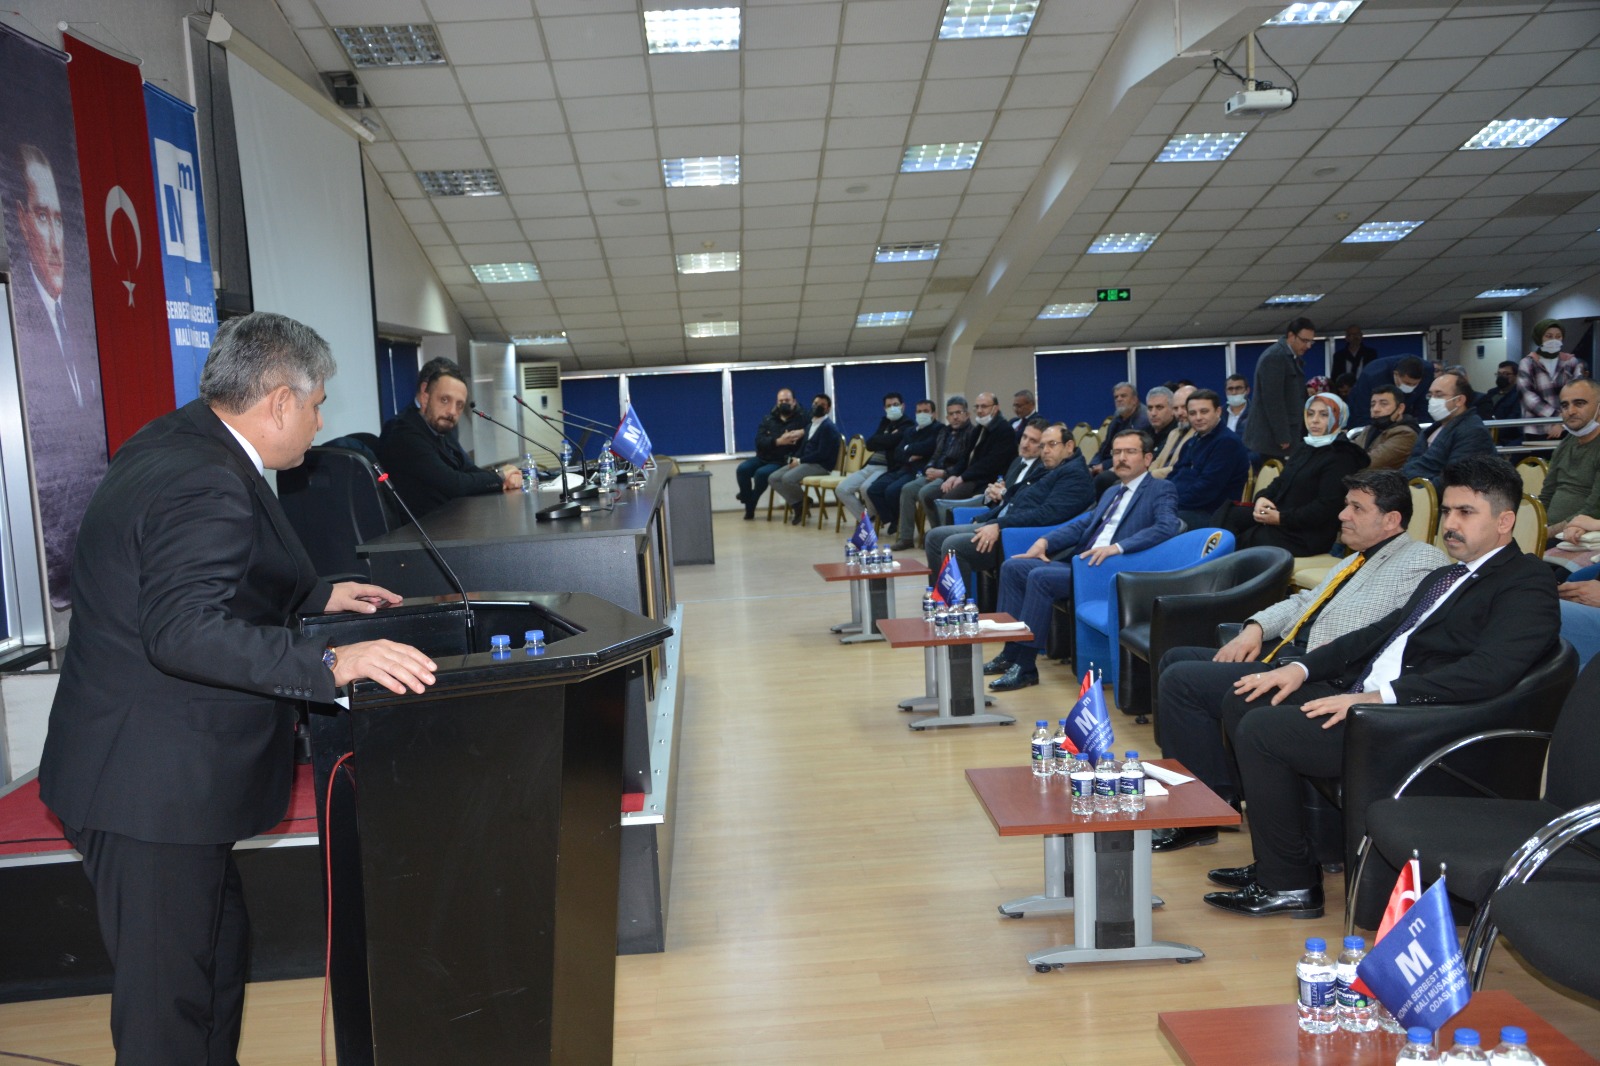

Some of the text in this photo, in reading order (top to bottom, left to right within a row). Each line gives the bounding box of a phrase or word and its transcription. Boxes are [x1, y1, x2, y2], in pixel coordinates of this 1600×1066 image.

[622, 424, 642, 444] M
[858, 528, 868, 541] M
[941, 573, 956, 590] M
[1082, 696, 1092, 706] m
[1074, 707, 1099, 737] M
[1408, 917, 1426, 938] m
[1394, 938, 1433, 986] M
[1411, 970, 1439, 1002] SERBEST
[1438, 950, 1463, 974] MUHAS
[1414, 961, 1466, 1014] MALİ MÜŞAVİRLE
[1429, 976, 1467, 1013] ODASI 1990
